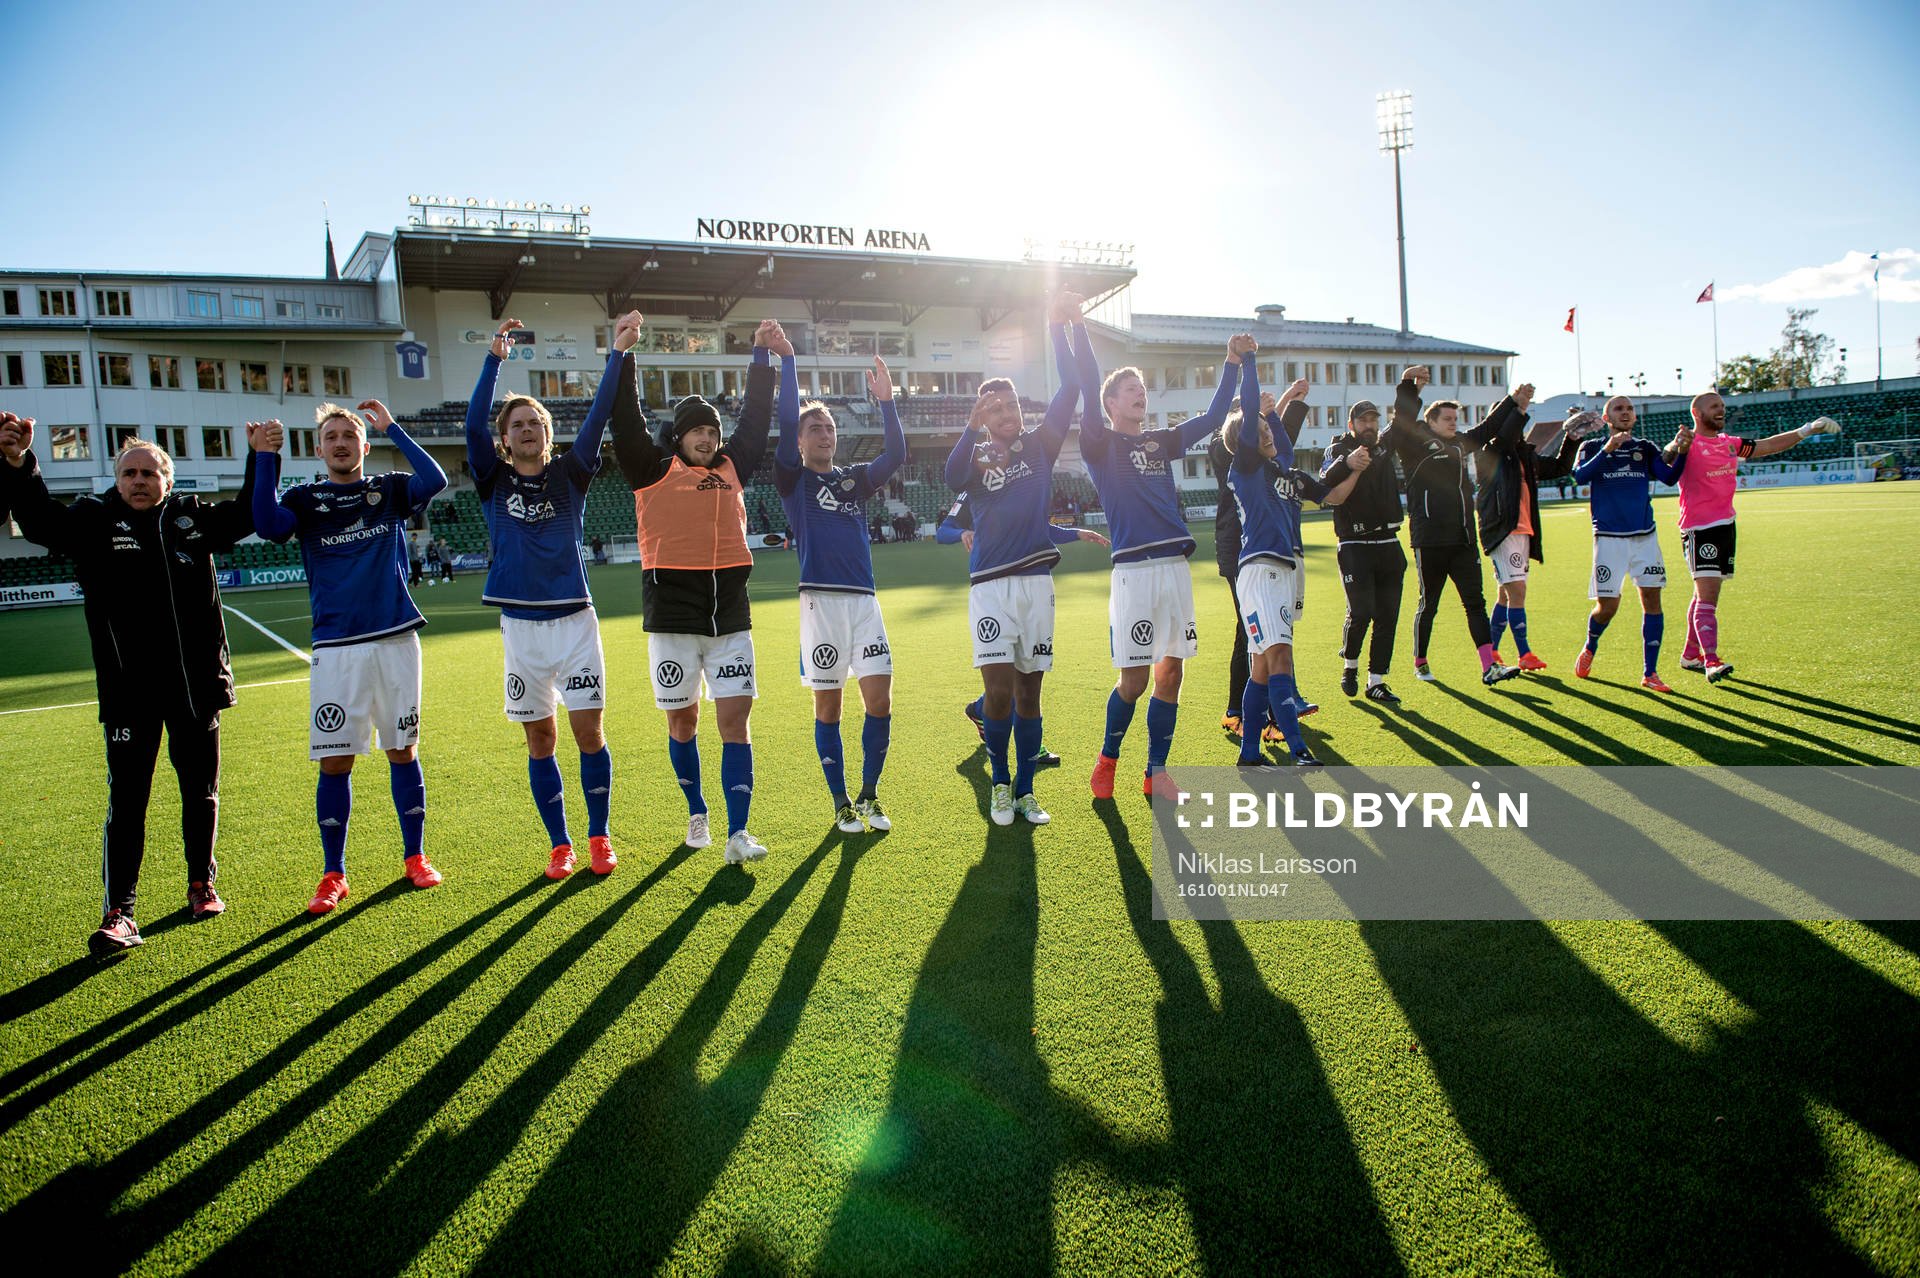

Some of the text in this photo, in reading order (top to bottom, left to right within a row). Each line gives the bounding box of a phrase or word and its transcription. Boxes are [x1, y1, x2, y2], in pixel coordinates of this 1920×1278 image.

[697, 217, 931, 250] NORRPORTEN ARENA
[407, 352, 418, 365] 10
[1006, 460, 1029, 477] SCA
[1603, 471, 1646, 479] NORRPORTEN
[697, 482, 732, 491] adidas
[527, 500, 554, 516] SCA
[321, 524, 389, 547] NORRPORTEN
[716, 663, 753, 679] ABAX
[565, 675, 601, 692] ABAX
[111, 727, 131, 742] J.S
[312, 742, 351, 751] BERNERS
